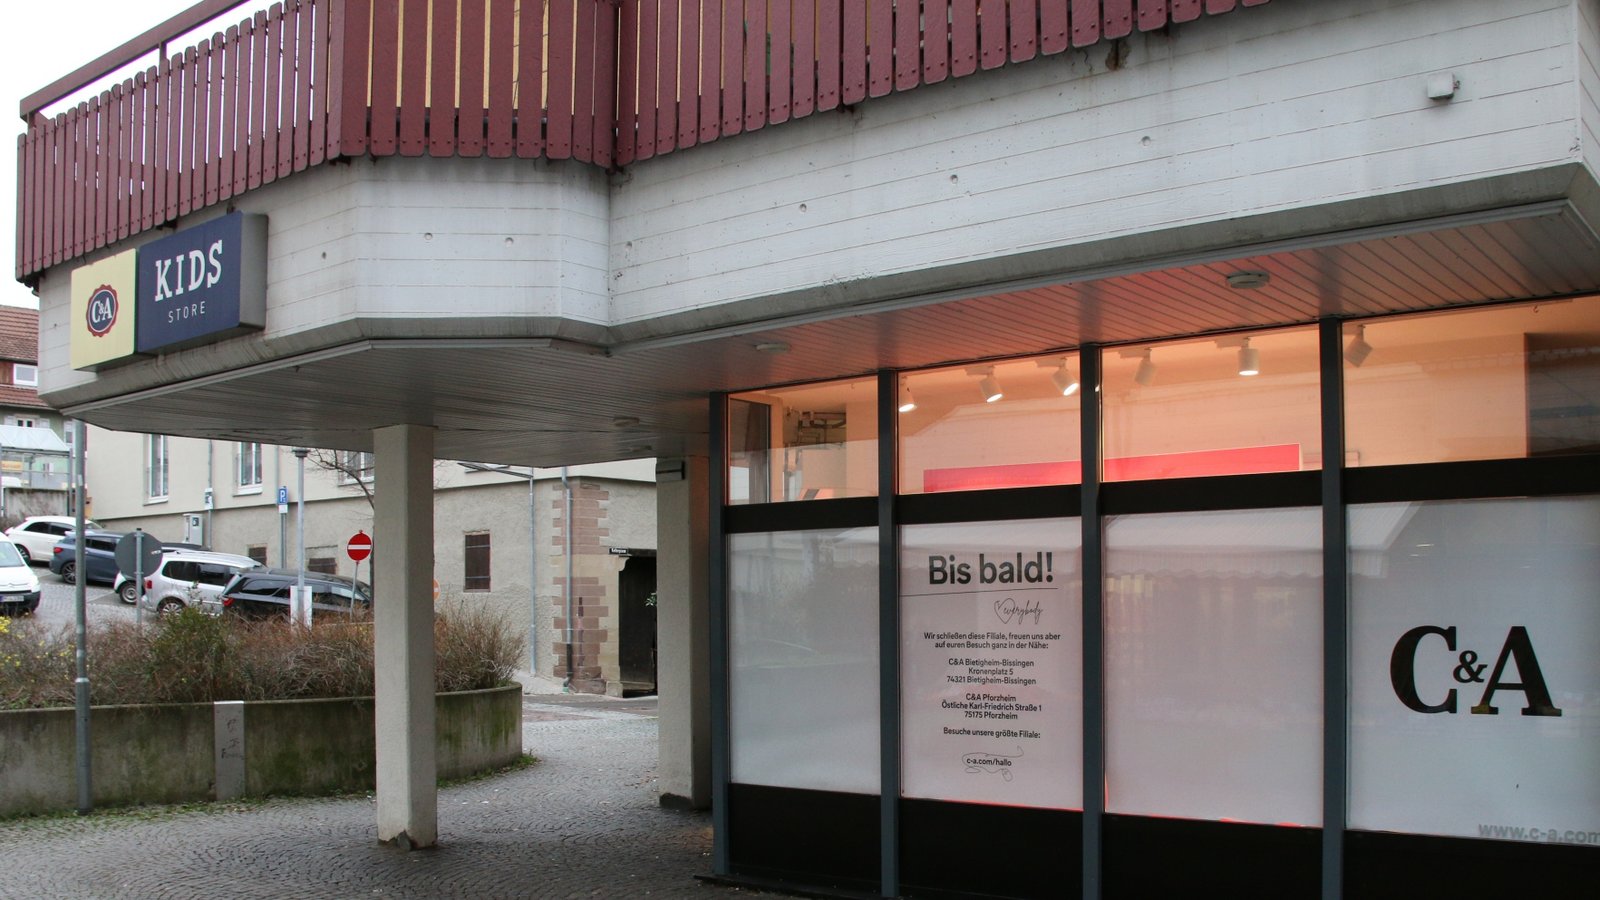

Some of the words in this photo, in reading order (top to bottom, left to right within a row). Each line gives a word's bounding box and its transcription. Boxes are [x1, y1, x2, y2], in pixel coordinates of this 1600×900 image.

[154, 239, 223, 302] KIDS
[91, 296, 113, 324] C&A
[168, 300, 206, 324] STORE
[928, 554, 972, 585] Bis
[979, 551, 1054, 584] bald!
[924, 632, 935, 640] Wir
[936, 632, 967, 640] schließen
[967, 632, 986, 640] diese
[986, 632, 1008, 641] Filiale,
[1008, 632, 1031, 640] freuen
[934, 641, 946, 649] auf
[966, 641, 991, 649] Besuch
[948, 658, 965, 666] C&A
[965, 659, 1035, 668] Bietigheim-Bissingen
[968, 667, 1008, 676] Kronenplatz
[1009, 668, 1014, 676] 5
[1390, 625, 1562, 717] C&A
[947, 676, 966, 684] 74321
[967, 676, 1037, 686] Bietigheim-Bissingen
[965, 693, 982, 701] C&A
[982, 694, 1017, 702] Pforzheim
[941, 699, 969, 709] Östliche
[969, 702, 1014, 711] Karl-Friedrich
[1014, 703, 1038, 712] Straße
[964, 711, 983, 719] 75175
[983, 711, 1018, 720] Pforzheim
[943, 727, 971, 736] Besuche
[995, 730, 1018, 738] größte
[1018, 730, 1041, 739] Filiale:
[966, 758, 1012, 766] c-a.com/hallo
[1478, 823, 1600, 844] www.c-a.com
